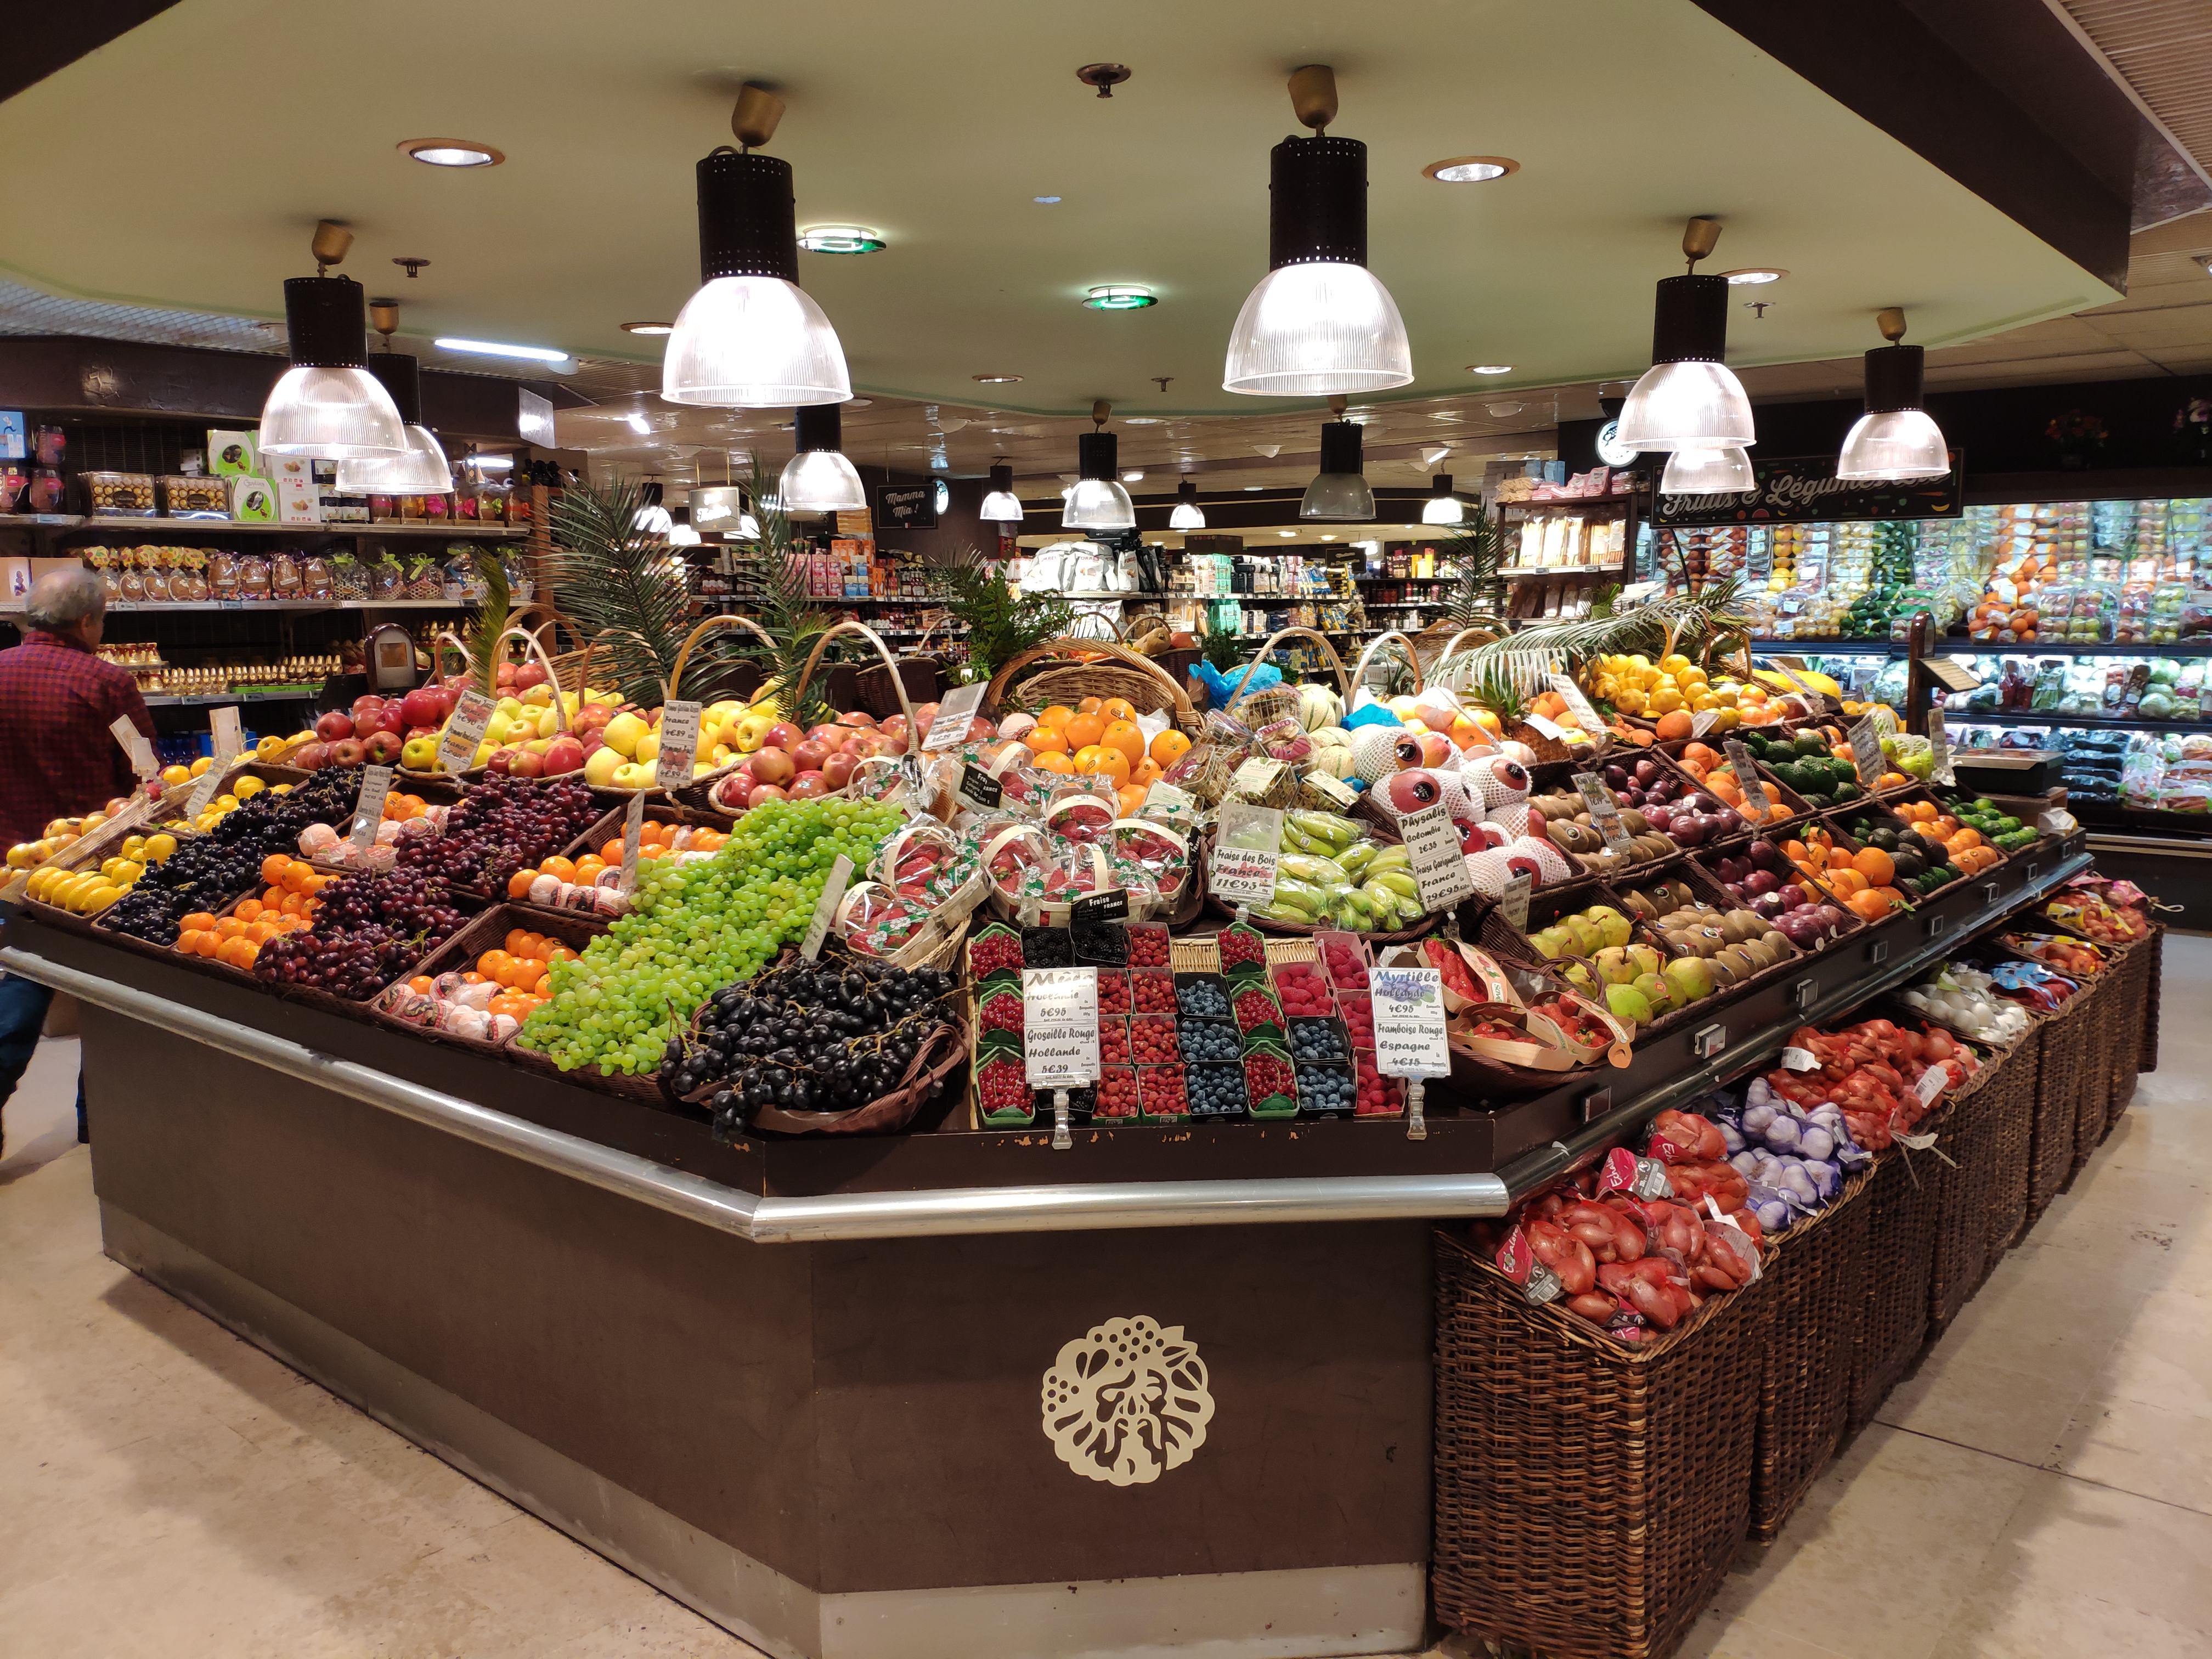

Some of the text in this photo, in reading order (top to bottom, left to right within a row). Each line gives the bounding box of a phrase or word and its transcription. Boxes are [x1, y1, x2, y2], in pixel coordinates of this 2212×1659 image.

[885, 491, 926, 505] Mamma
[893, 506, 913, 519] Mia
[664, 715, 690, 724] France
[1246, 763, 1275, 771] PHYSALIS
[1401, 806, 1446, 830] Physalis
[1407, 825, 1441, 843] Colombie
[1418, 841, 1437, 854] 2€35
[1217, 849, 1276, 866] Fraise des Bois
[1216, 864, 1261, 877] France
[1415, 863, 1432, 876] Fraise
[1216, 878, 1257, 890] 11€95
[1421, 871, 1456, 889] France
[1425, 884, 1459, 903] 29€95
[1088, 896, 1110, 907] Fraise
[1103, 900, 1123, 910] FRANCE
[1374, 971, 1438, 984] Myrtille
[1375, 988, 1425, 998] Hollande
[1040, 1007, 1067, 1017] 5€95
[1389, 1005, 1414, 1013] 4€95
[1028, 1028, 1094, 1043] Groseille Rouge
[1378, 1023, 1443, 1037] Framboise Rouge
[1029, 1046, 1081, 1058] Hollande
[1379, 1040, 1431, 1052] Espagne
[1392, 1057, 1420, 1066] 4€15
[1042, 1064, 1069, 1074] 5€39
